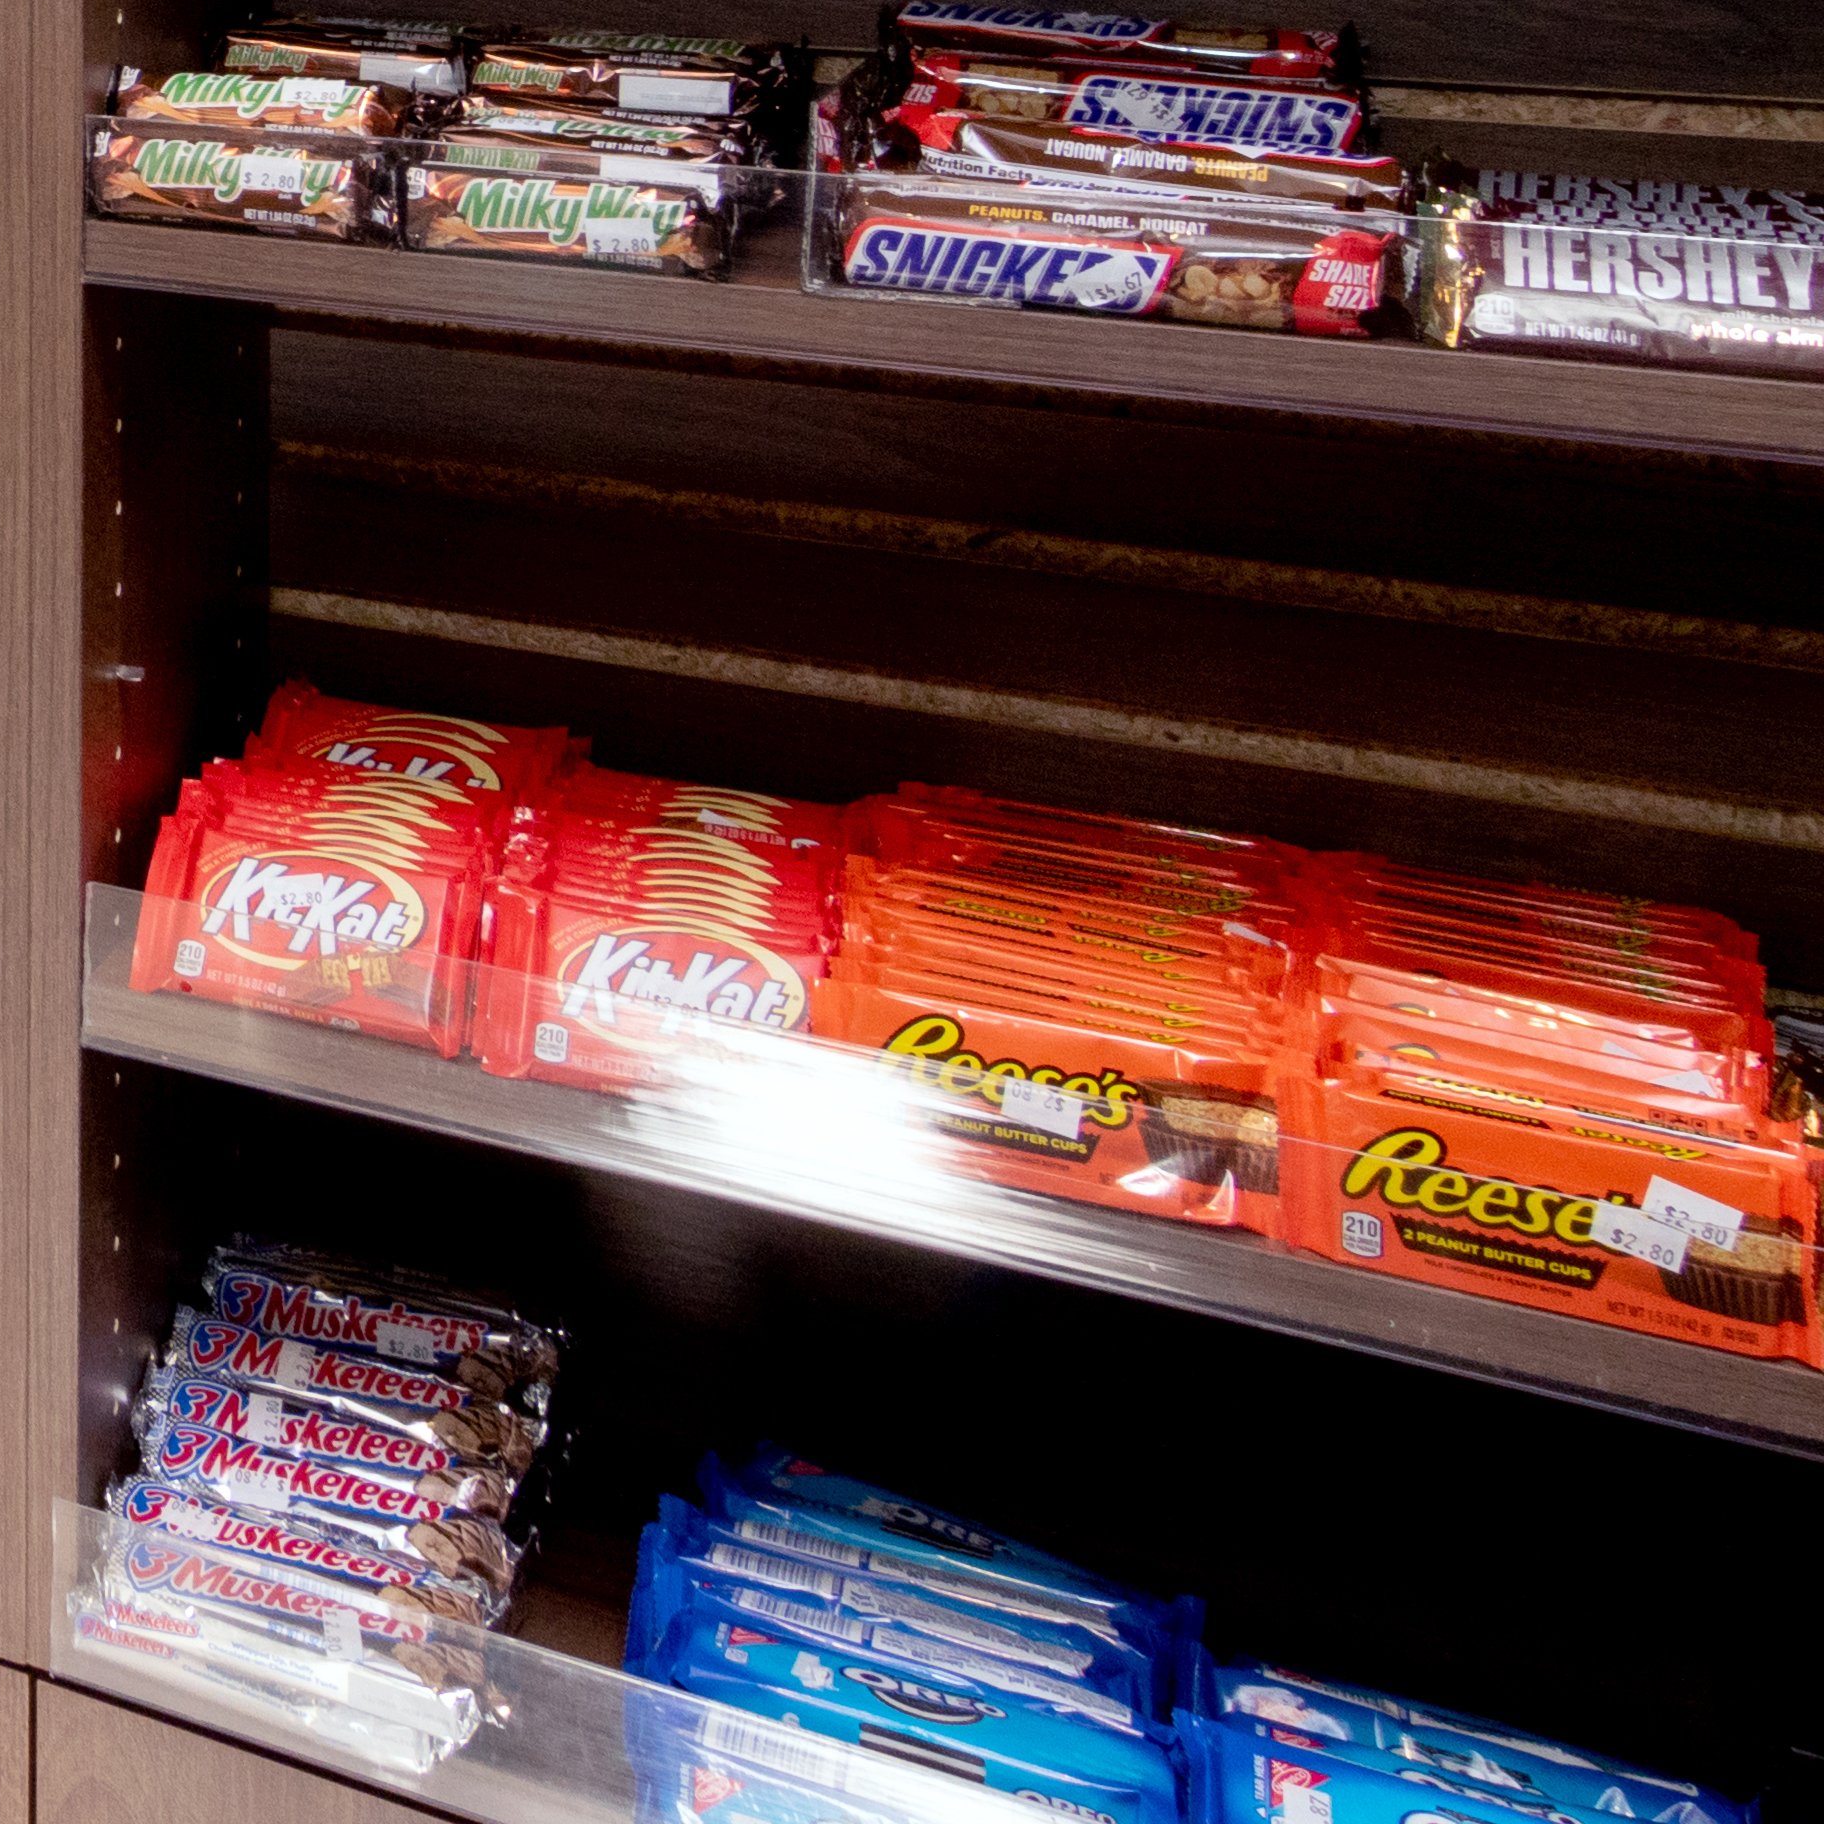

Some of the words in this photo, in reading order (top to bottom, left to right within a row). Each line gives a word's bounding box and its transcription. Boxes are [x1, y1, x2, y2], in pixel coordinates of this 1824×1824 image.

[988, 163, 1033, 181] Facts
[1140, 216, 1208, 237] NOUGAT
[860, 229, 1165, 312] SNICKE
[1310, 258, 1374, 284] SHARE
[1503, 225, 1816, 310] HERSHEY
[1323, 284, 1374, 308] SIZE
[1691, 323, 1768, 343] whole
[177, 942, 202, 959] 210
[540, 1026, 564, 1042] 210
[994, 1126, 1047, 1149] BUTTER
[1051, 1136, 1087, 1159] CUPS
[1344, 1128, 1631, 1244] Reese'
[1345, 1216, 1379, 1239] 210
[1404, 1228, 1414, 1242] 2
[1418, 1232, 1478, 1256] PEANUT
[1483, 1246, 1545, 1269] BUTTER
[1548, 1262, 1591, 1281] CUPS
[1610, 1227, 1674, 1264] $2.80
[223, 1280, 263, 1322] 3
[164, 1429, 205, 1468] 3
[842, 1667, 1006, 1719] OREO
